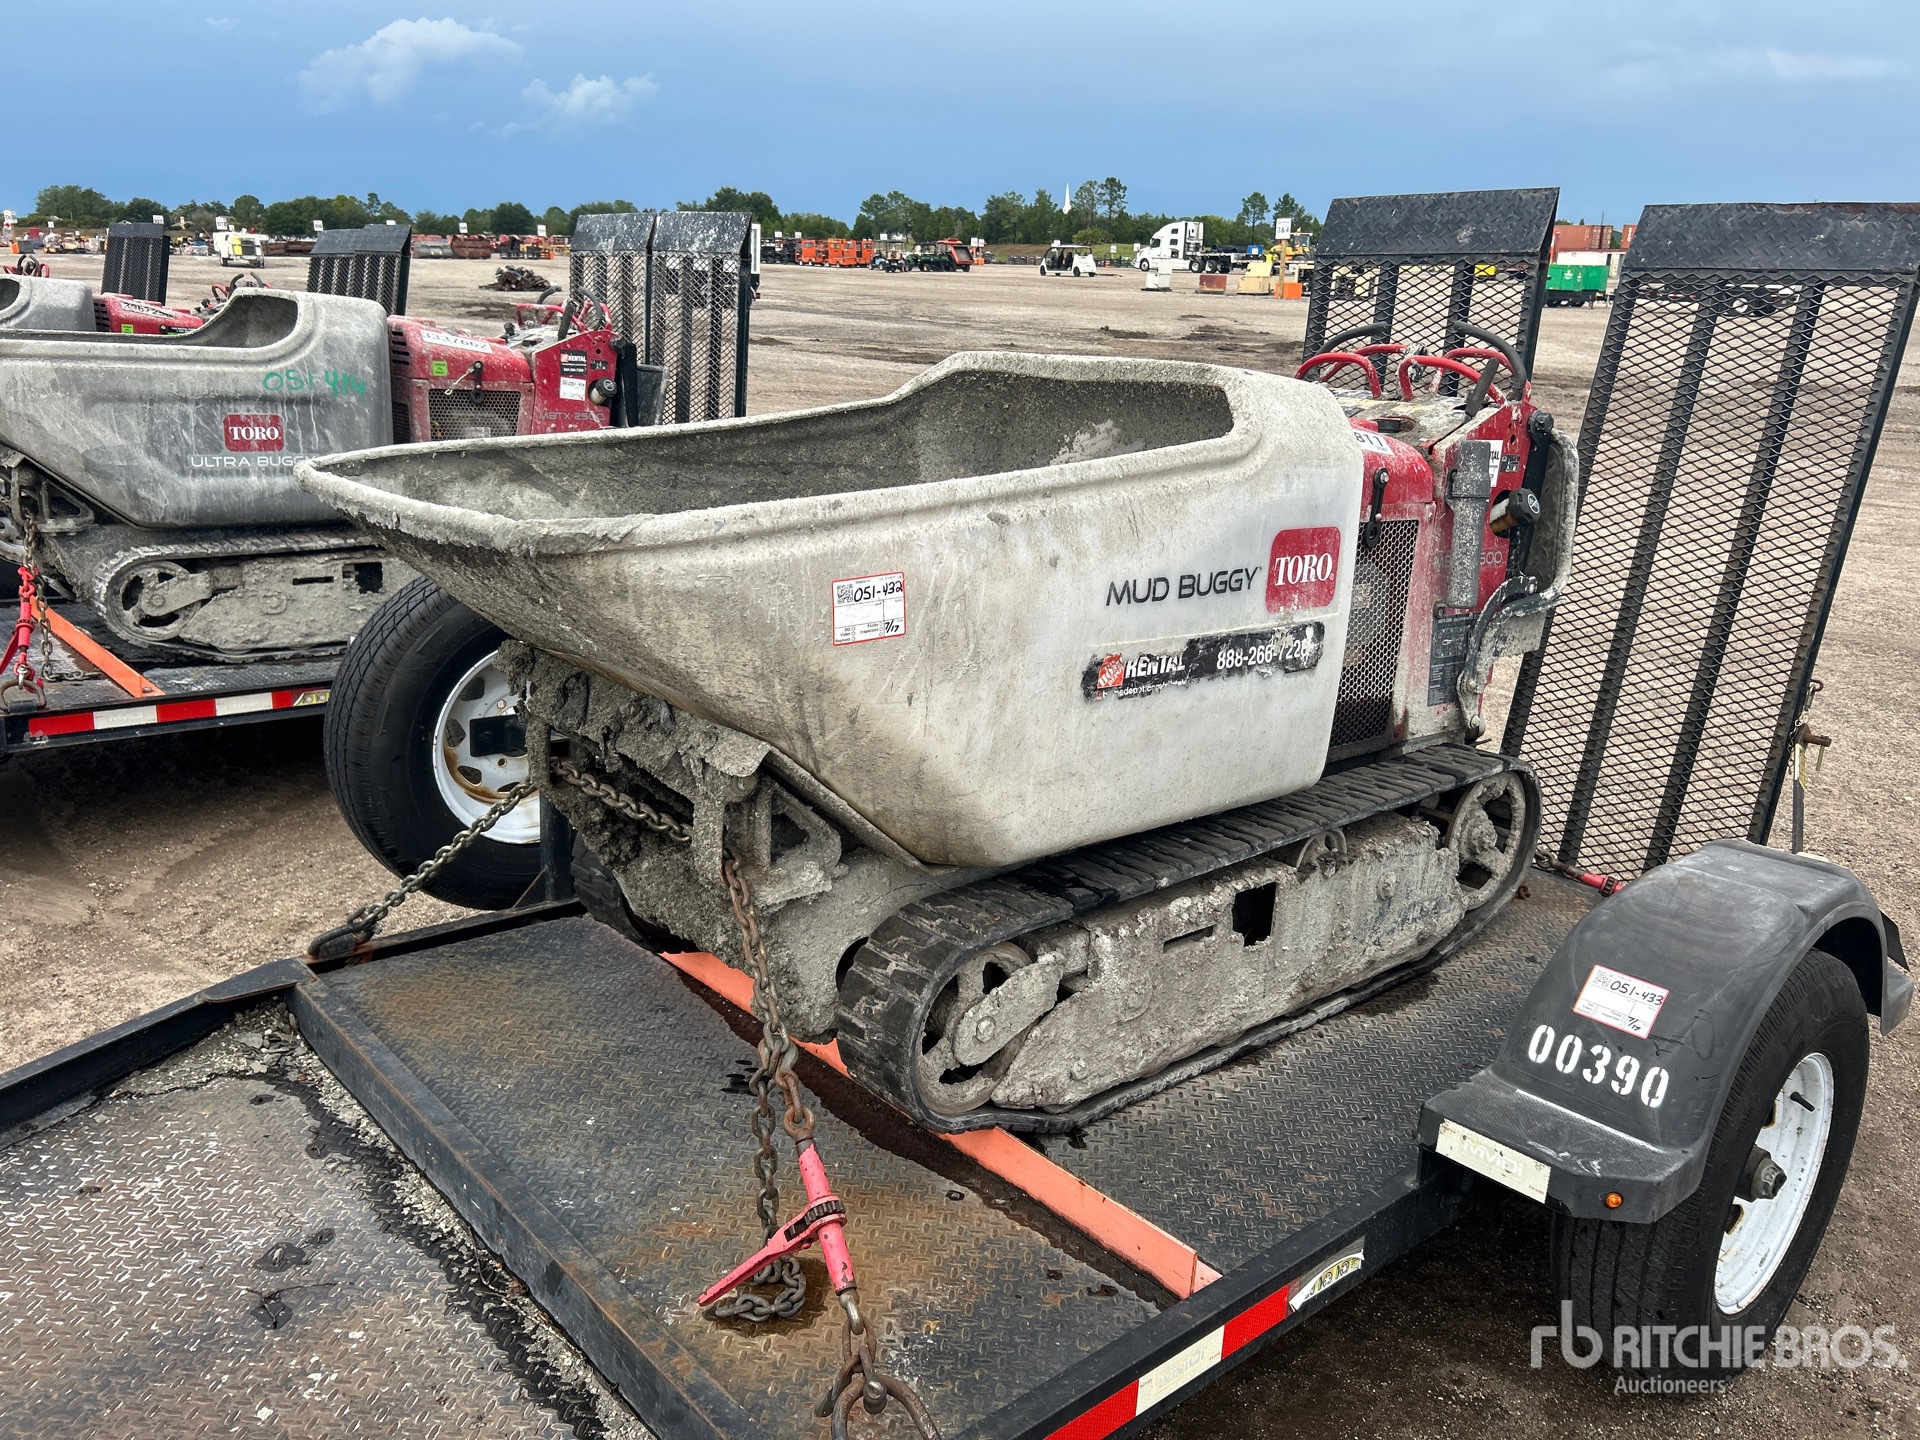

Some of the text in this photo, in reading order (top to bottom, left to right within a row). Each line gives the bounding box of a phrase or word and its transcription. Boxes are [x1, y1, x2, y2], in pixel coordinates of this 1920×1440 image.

[325, 369, 366, 400] 414
[229, 426, 279, 441] TORO
[191, 456, 250, 467] ULTRA
[1274, 552, 1333, 586] TORO
[854, 580, 903, 602] 051-432
[1106, 566, 1259, 606] MUD BUGGY
[1125, 654, 1186, 678] RENTAL
[1610, 980, 1664, 1006] 051-433
[1527, 1024, 1670, 1108] 00390
